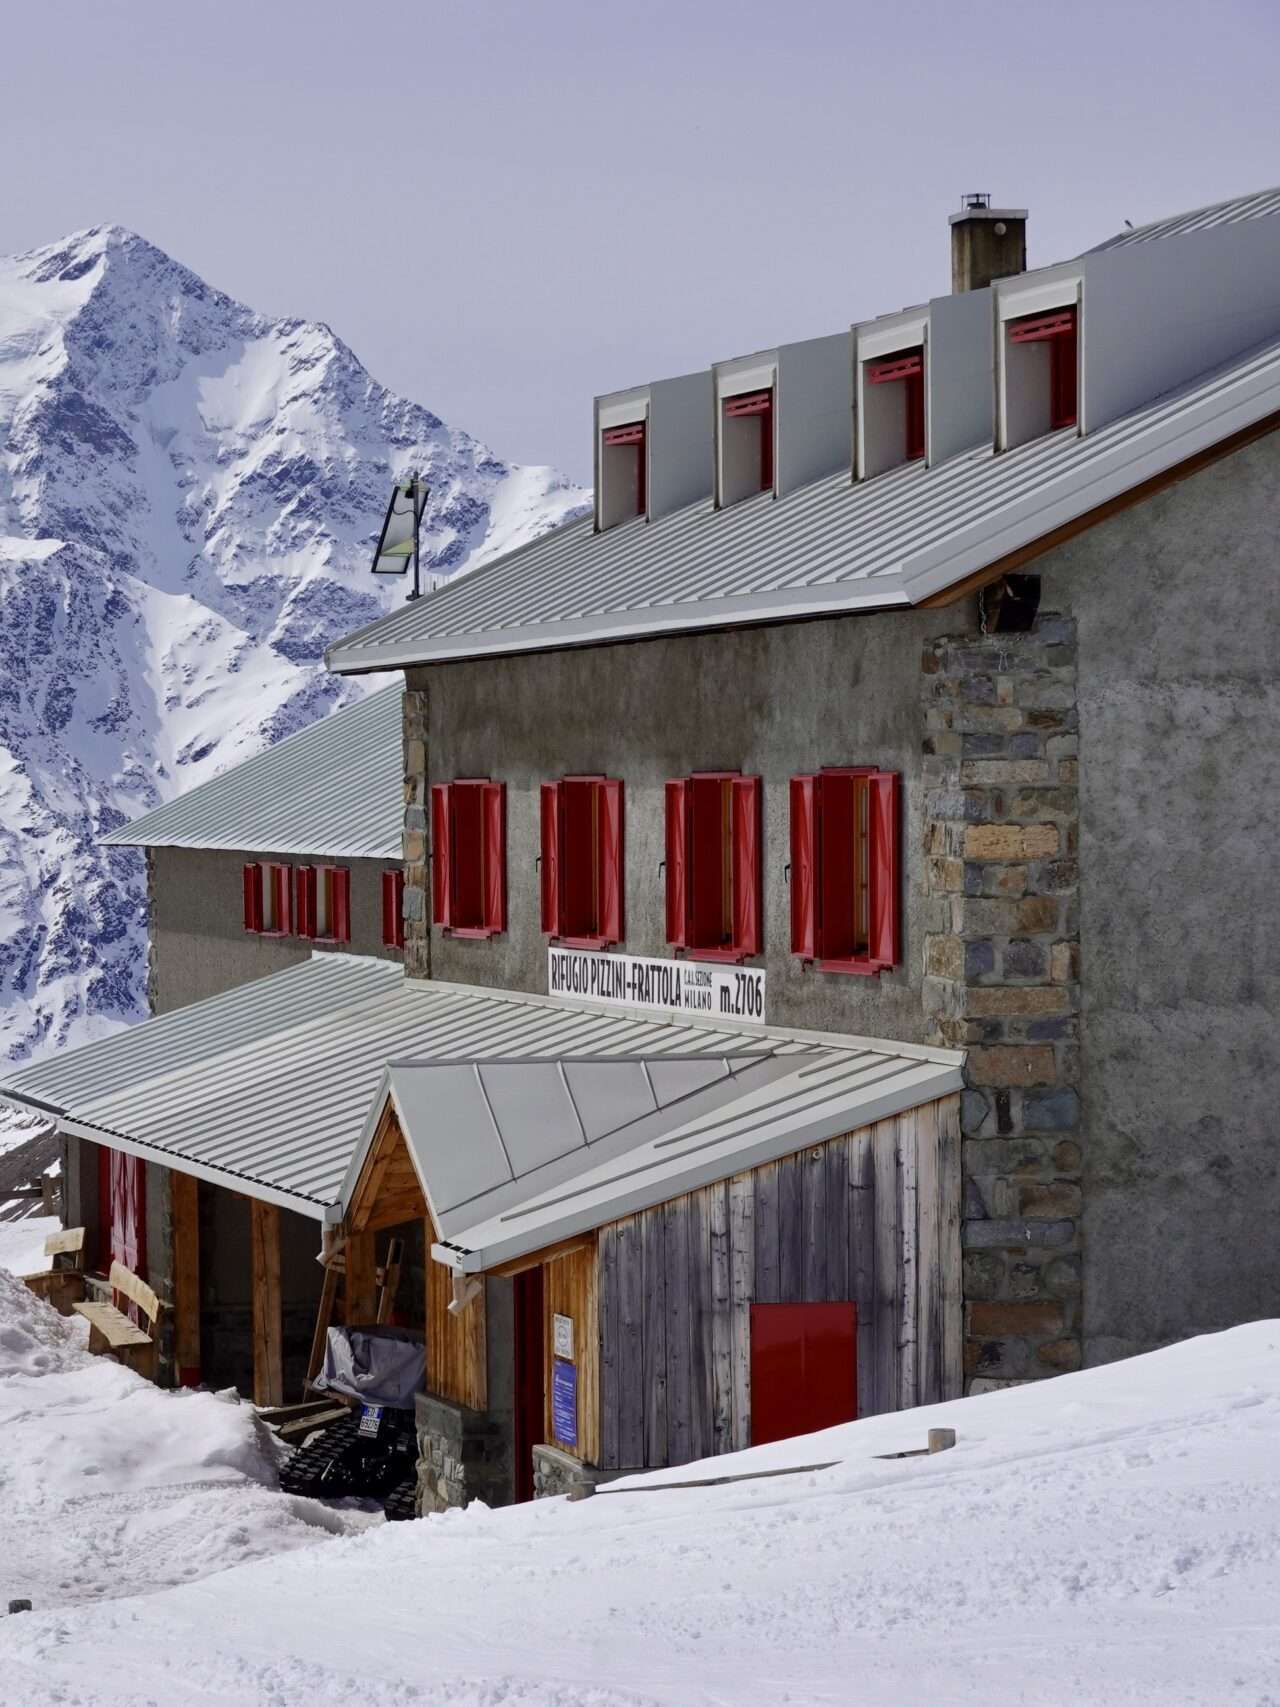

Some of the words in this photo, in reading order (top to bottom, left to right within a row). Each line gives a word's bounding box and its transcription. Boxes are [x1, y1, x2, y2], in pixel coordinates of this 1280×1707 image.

[551, 953, 589, 995] RIFUGIO
[590, 957, 682, 1008] PIZZINI-FRATTOLA
[684, 989, 712, 1011] MILANO
[720, 972, 763, 1018] m.2706
